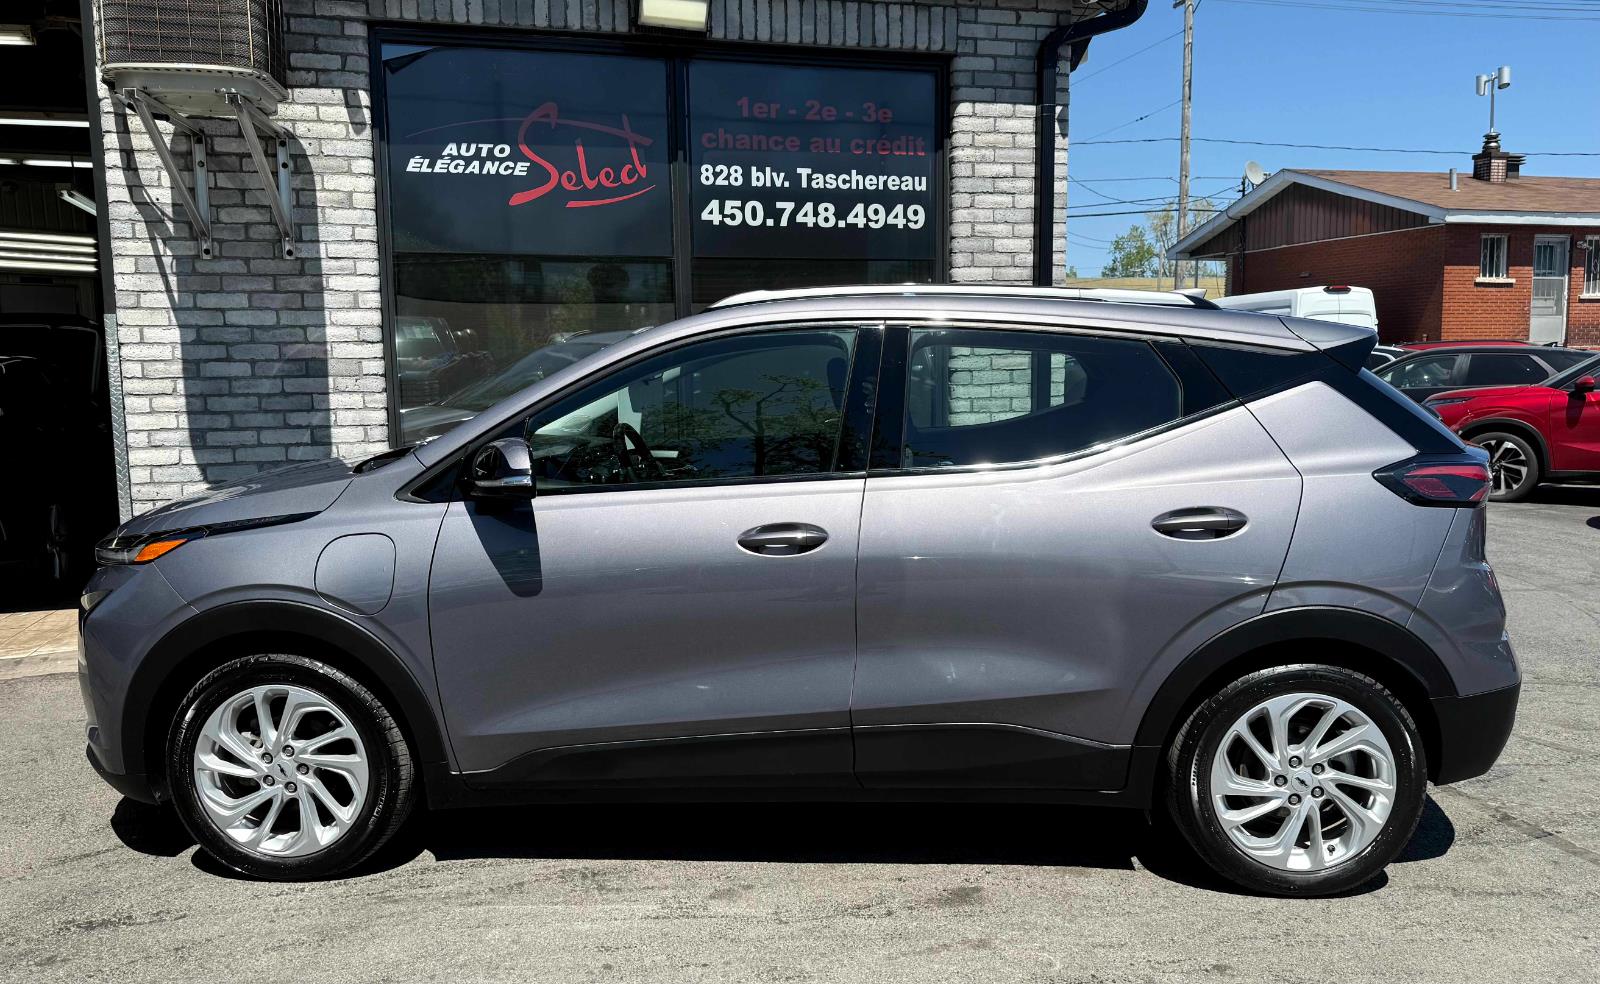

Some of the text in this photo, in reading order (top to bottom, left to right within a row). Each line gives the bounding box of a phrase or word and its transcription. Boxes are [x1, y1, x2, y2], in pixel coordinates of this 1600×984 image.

[736, 97, 780, 118] 1er
[805, 100, 837, 120] 2e
[863, 102, 893, 123] 3e
[442, 142, 511, 158] AUTO
[702, 128, 927, 156] chance au crédit
[406, 156, 531, 176] ÉLÉGANCE
[700, 164, 927, 191] 828 blv. Taschereau
[701, 200, 926, 230] 450.748.4949
